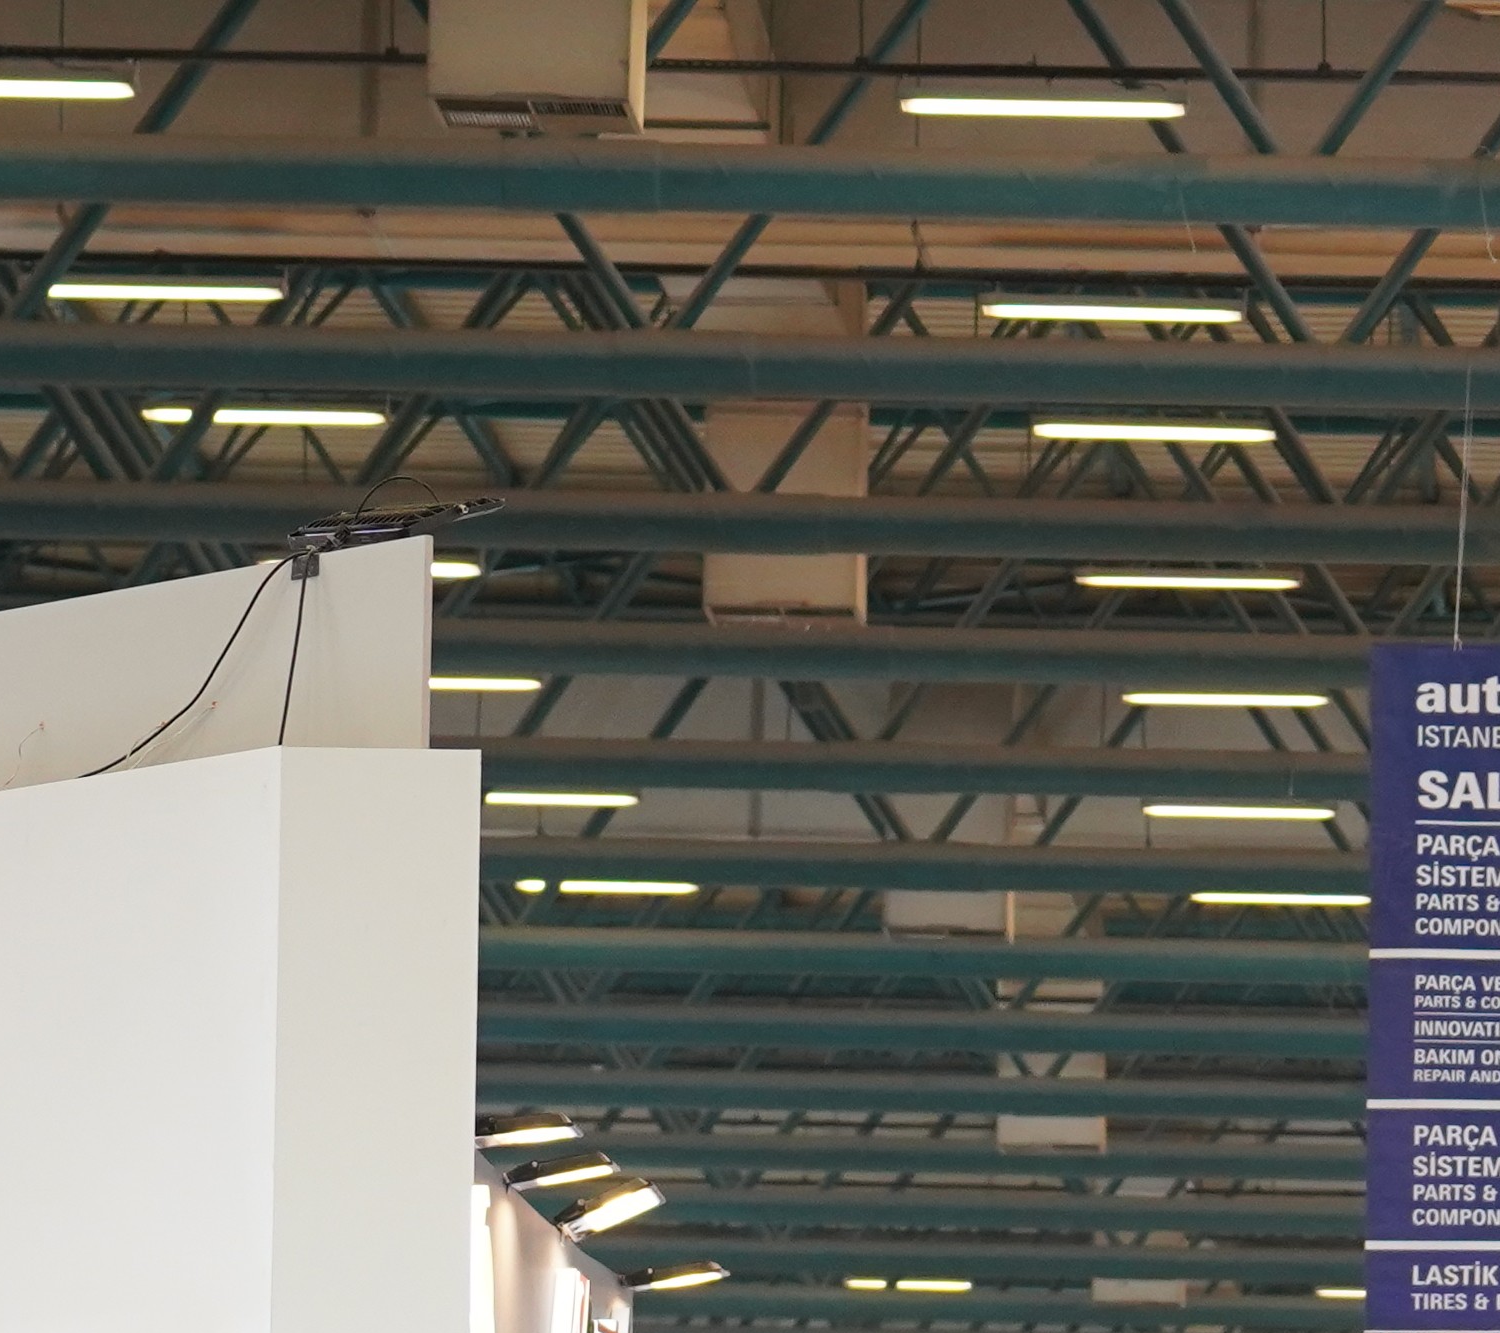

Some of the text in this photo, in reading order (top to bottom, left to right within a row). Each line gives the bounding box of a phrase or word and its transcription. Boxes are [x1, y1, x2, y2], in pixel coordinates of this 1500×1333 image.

[1417, 834, 1500, 861] PARÇA
[1416, 893, 1500, 911] PARTS &
[1415, 975, 1476, 994] PARÇA
[1415, 995, 1461, 1008] PARTS
[1465, 996, 1476, 1008] &
[1414, 1049, 1474, 1064] BAKIM
[1414, 1069, 1465, 1082] REPAIR
[1414, 1125, 1497, 1151] PARÇA
[1413, 1184, 1498, 1201] PARTS &
[1413, 1261, 1498, 1286] LASTİK
[1411, 1293, 1467, 1310] TIRES
[1474, 1293, 1489, 1310] &
